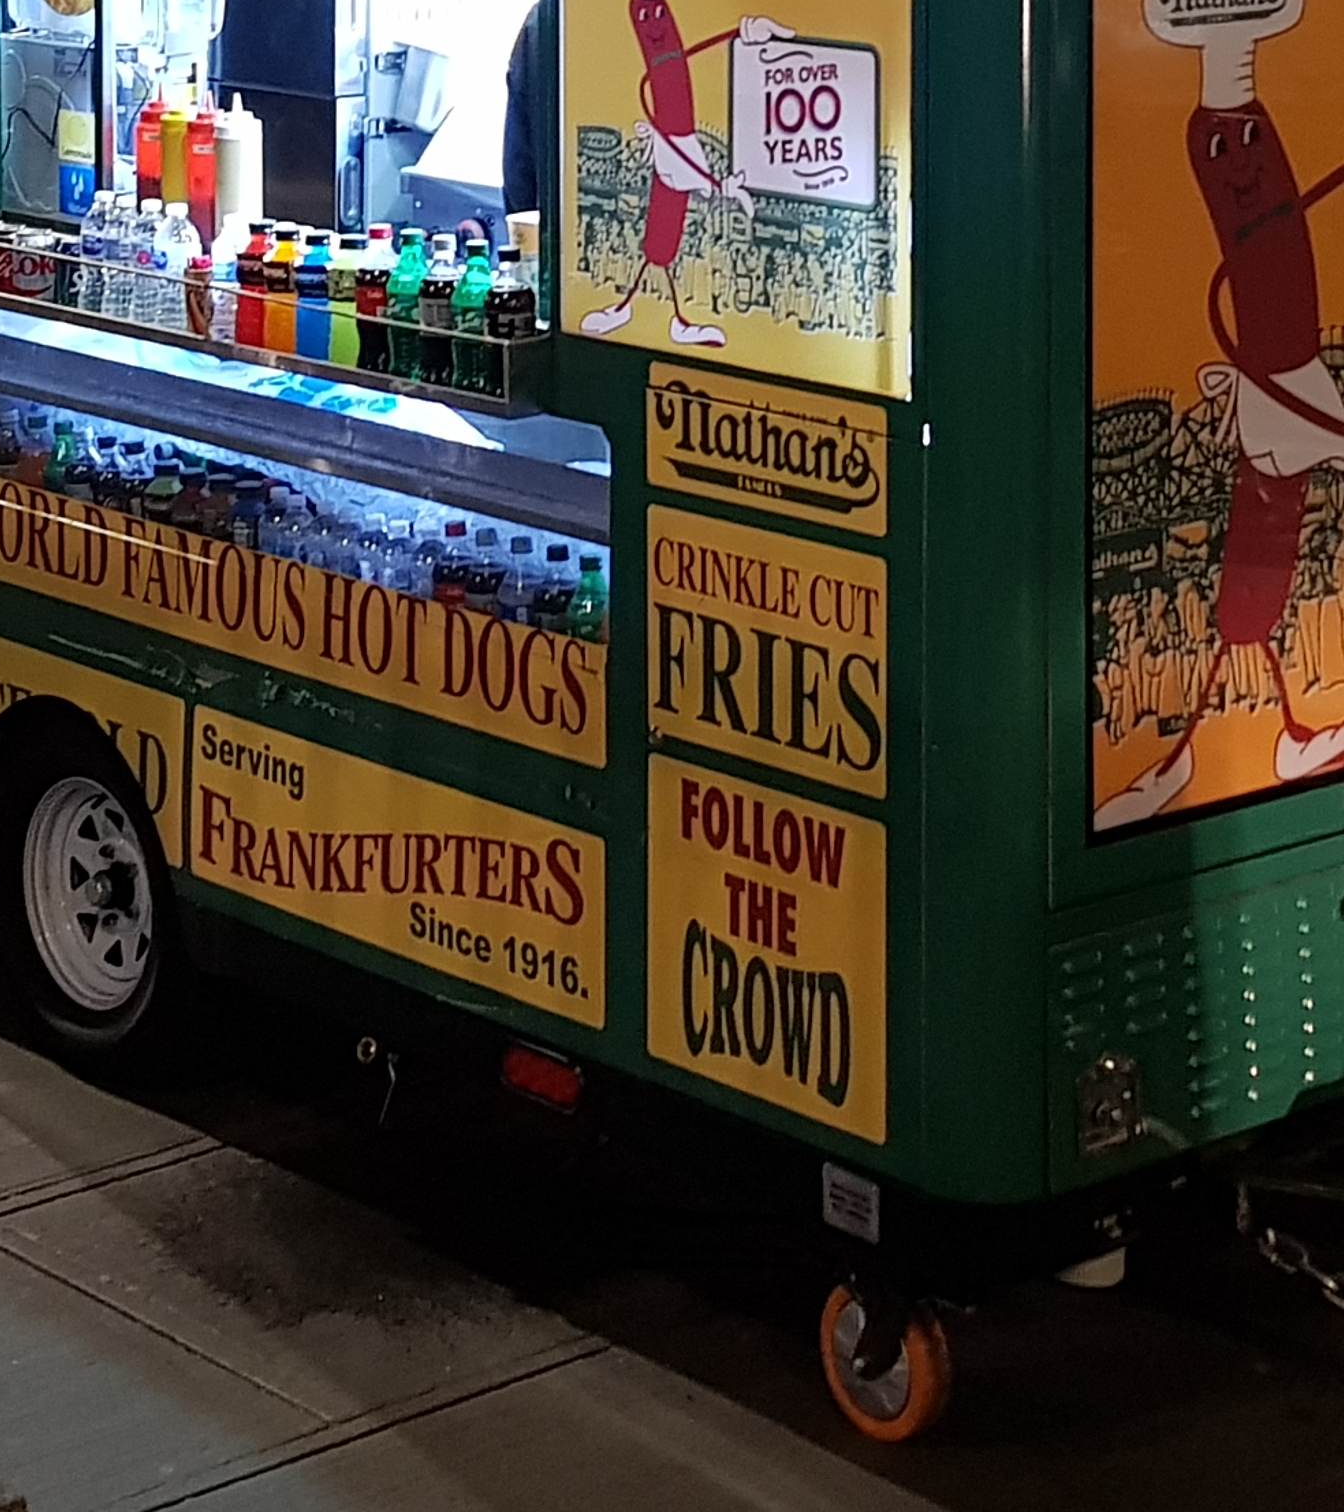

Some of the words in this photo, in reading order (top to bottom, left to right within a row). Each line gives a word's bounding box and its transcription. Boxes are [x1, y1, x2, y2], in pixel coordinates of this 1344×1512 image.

[765, 68, 794, 86] FOR
[799, 63, 838, 83] OVER
[765, 85, 841, 135] 100
[764, 137, 843, 165] YEARS
[654, 380, 872, 489] Nathan's
[122, 520, 307, 652] FAMOUS
[321, 575, 429, 685] HOT
[446, 605, 594, 736] DOGS
[655, 536, 799, 618] CRINKLE
[809, 573, 879, 638] CUT
[655, 603, 882, 772] FRIES
[202, 723, 304, 799] Serving
[198, 784, 584, 925] FRANKFURTERS
[681, 778, 846, 888] FOLLOW
[409, 901, 491, 963] Since
[502, 937, 590, 1000] 1916.
[724, 875, 797, 956] THE
[683, 919, 850, 1109] CROWD
